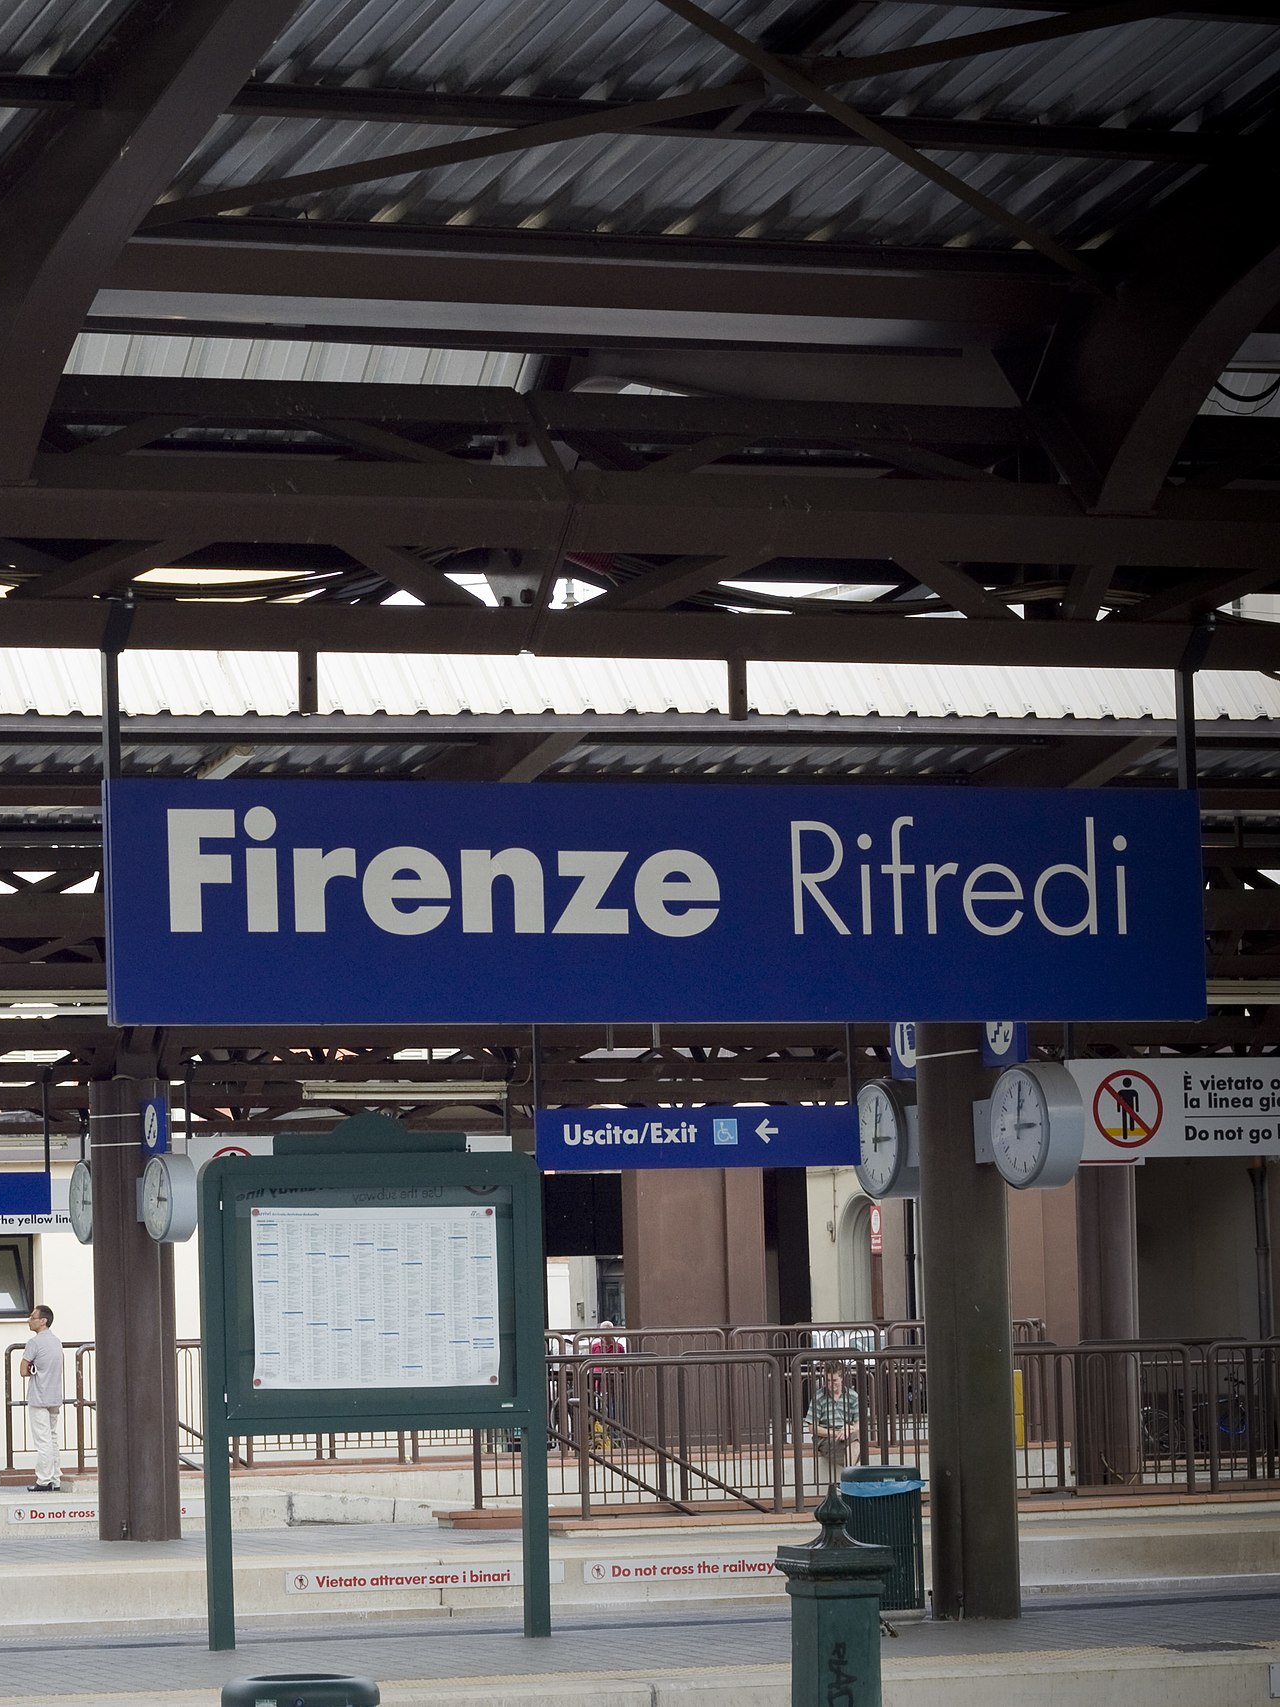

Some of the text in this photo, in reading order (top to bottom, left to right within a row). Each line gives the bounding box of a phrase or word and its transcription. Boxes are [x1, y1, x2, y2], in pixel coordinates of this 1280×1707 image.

[167, 806, 1127, 938] Firenze Rifredi
[1184, 1071, 1193, 1091] È
[1200, 1074, 1264, 1091] vietato
[1184, 1092, 1200, 1109] la
[1208, 1092, 1253, 1109] linea
[563, 1121, 698, 1146] Uscita/Exit
[1185, 1125, 1209, 1141] Do
[1214, 1126, 1243, 1141] not
[1249, 1128, 1273, 1144] go
[17, 1214, 54, 1226] yellow
[29, 1509, 96, 1520] Do not cross
[611, 1559, 776, 1578] Do not cross the railway
[315, 1574, 367, 1588] Vietato
[470, 1569, 511, 1583] binari
